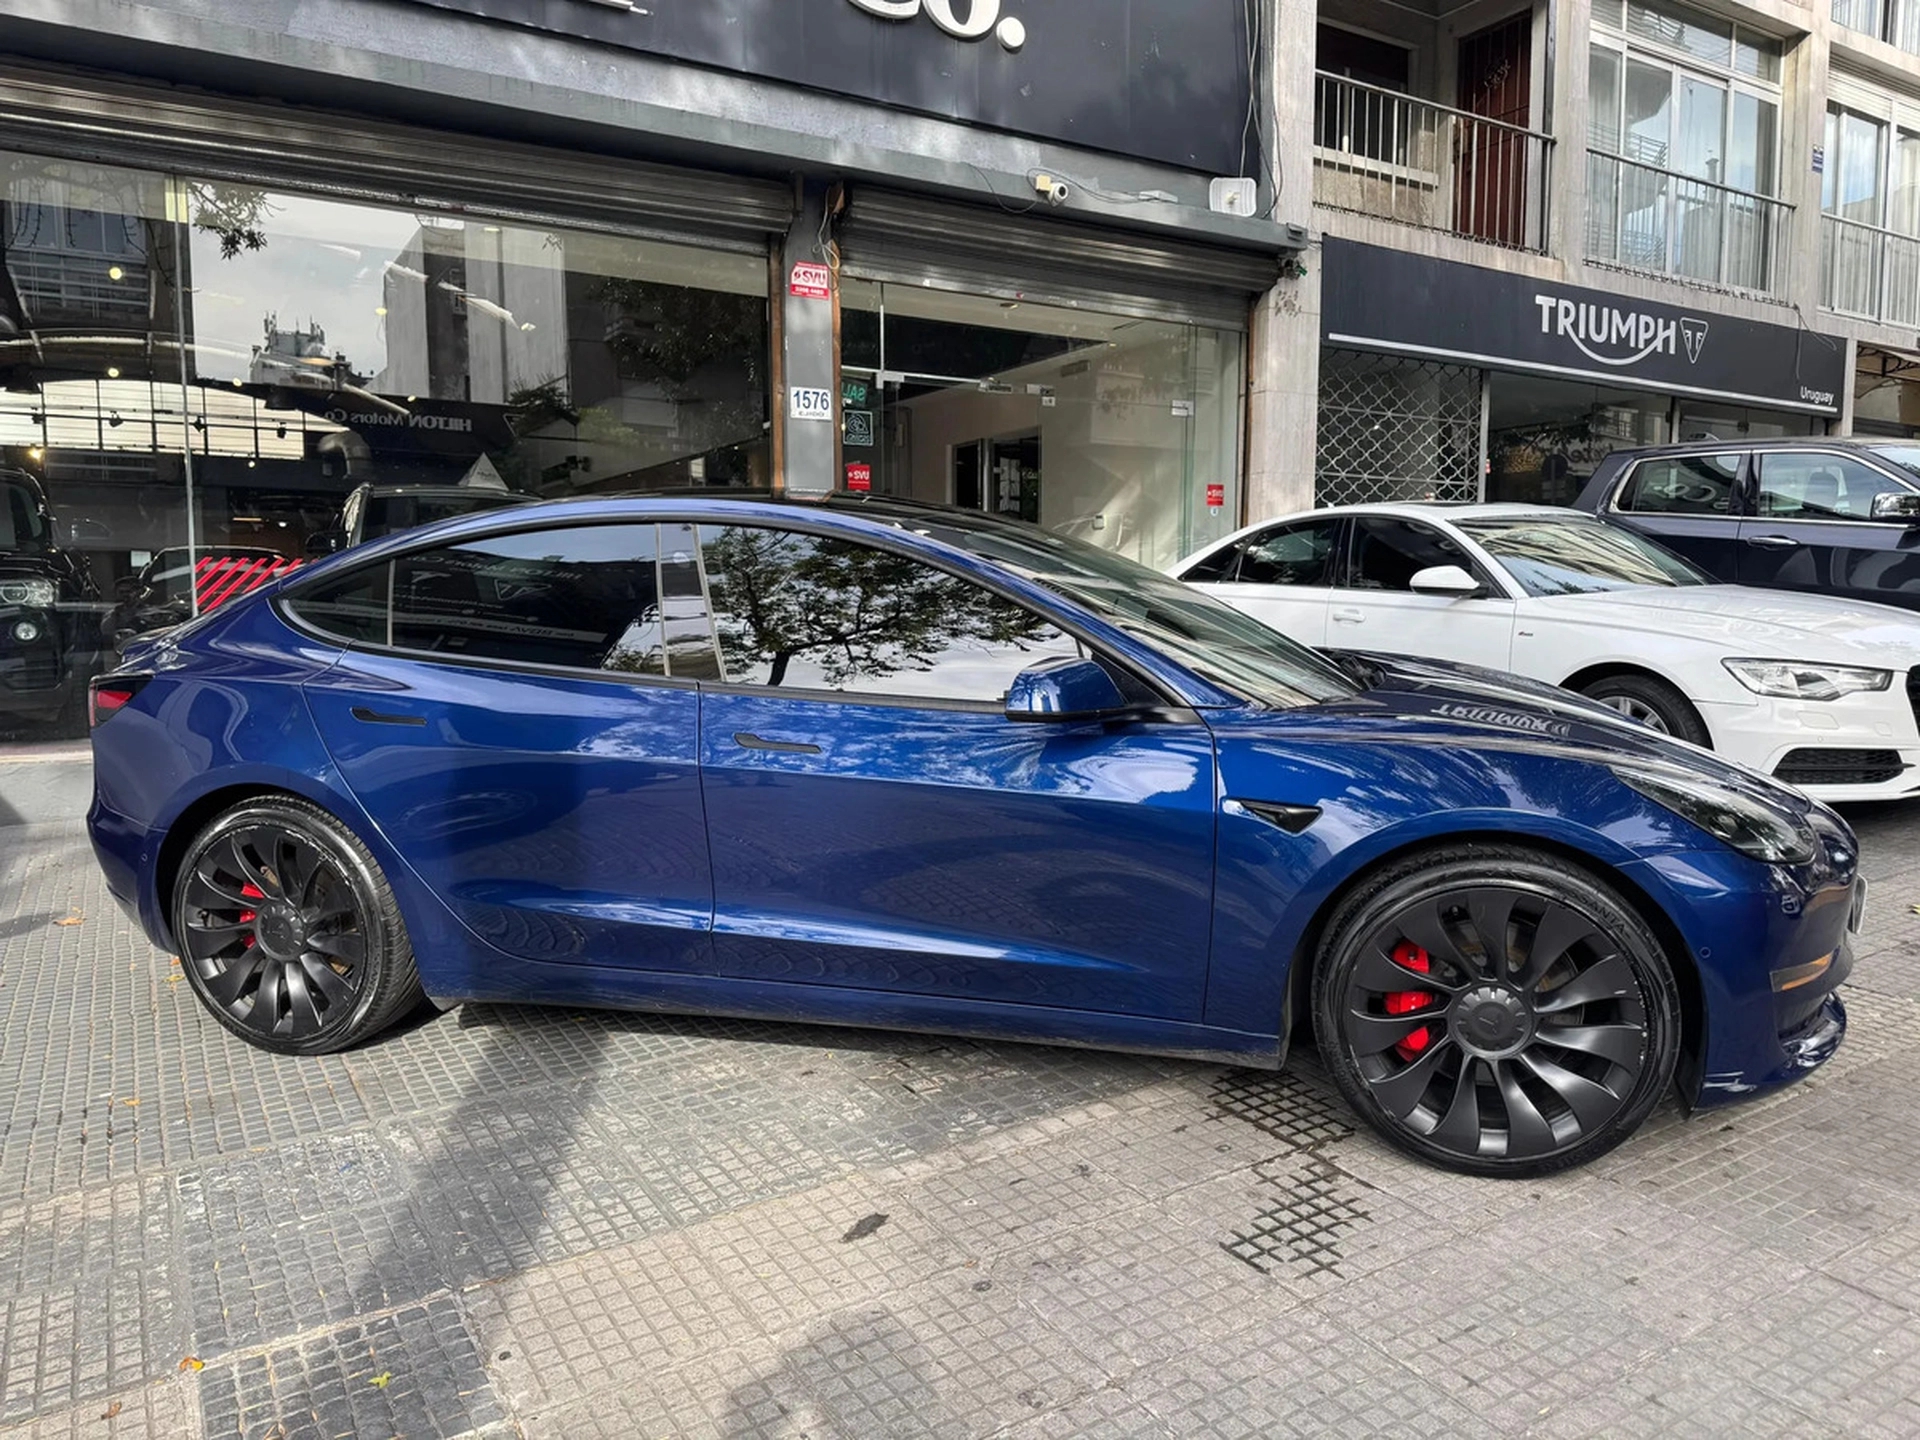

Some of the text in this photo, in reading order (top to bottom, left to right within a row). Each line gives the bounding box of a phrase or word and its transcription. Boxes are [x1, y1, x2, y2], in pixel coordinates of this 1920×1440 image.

[802, 270, 826, 285] SVU
[1535, 294, 1676, 365] TRIUMPH
[793, 390, 830, 411] 1576
[1801, 386, 1835, 406] Uruguay
